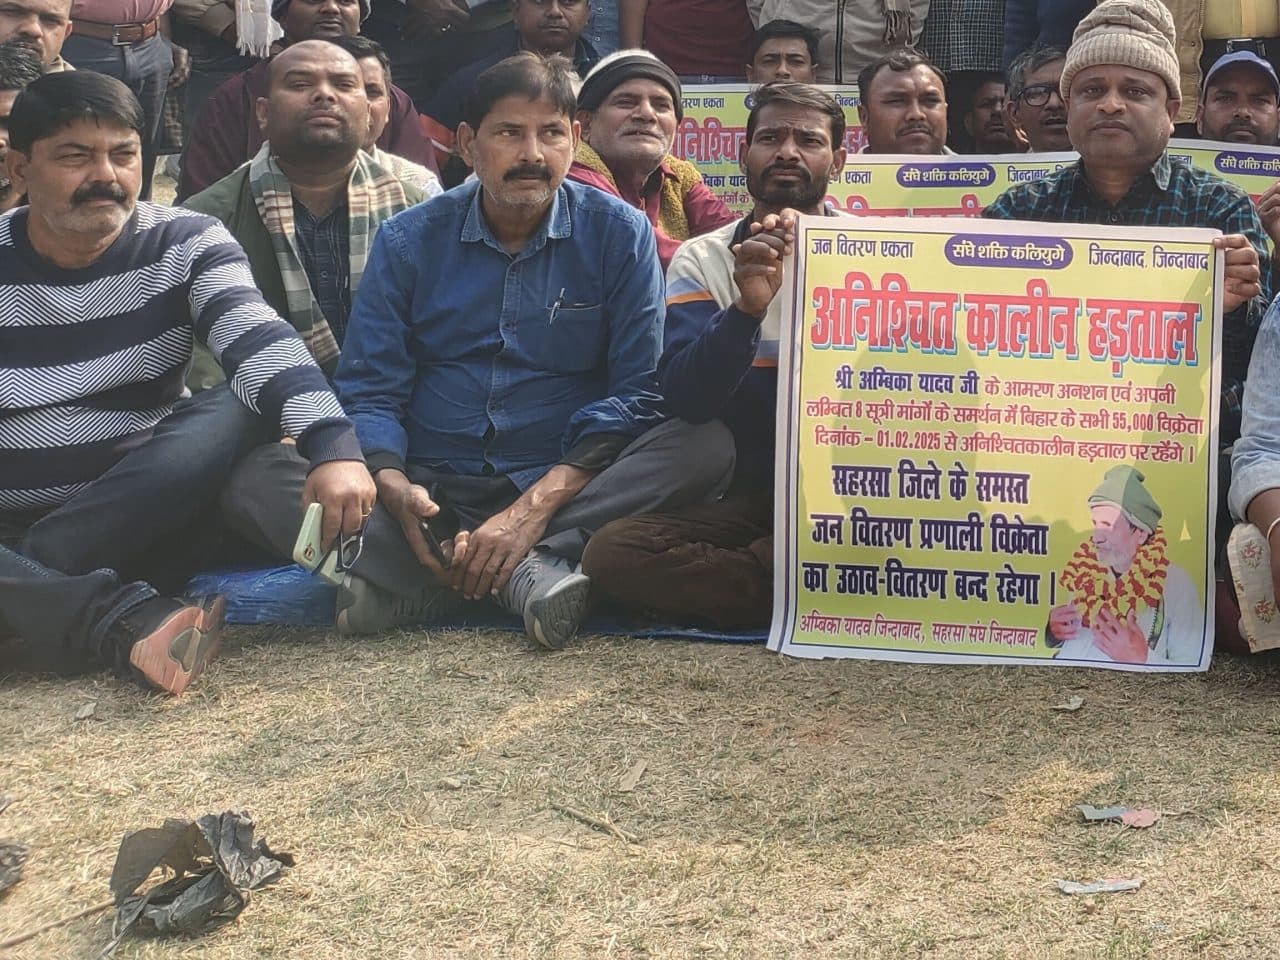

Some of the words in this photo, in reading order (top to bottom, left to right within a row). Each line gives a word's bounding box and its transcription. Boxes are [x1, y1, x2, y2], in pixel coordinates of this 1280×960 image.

[812, 239, 832, 255] जन
[837, 233, 877, 257] वितरण
[881, 241, 914, 258] एकता
[978, 242, 1010, 258] शक्ति
[1011, 243, 1065, 265] कलियुगे
[1153, 245, 1210, 271] जिन्दाबाद
[810, 271, 962, 353] अनिश्चित
[964, 278, 1082, 359] कालीन
[1086, 298, 1202, 378] हड़ताल
[835, 366, 854, 389] श्री
[859, 367, 913, 391] अम्बिका
[918, 374, 955, 393] यादव
[959, 370, 980, 394] जी
[985, 376, 1001, 395] के
[1004, 381, 1055, 398] आमरण
[1057, 384, 1108, 400] अनशन
[1111, 381, 1132, 402] एवं
[1134, 383, 1176, 404] अपनी
[806, 396, 853, 417] लम्बित
[856, 401, 862, 418] 8
[865, 399, 895, 425] सूत्री
[897, 400, 932, 421] मांगों
[935, 402, 951, 422] के
[953, 403, 1002, 424] समर्थन
[1004, 404, 1018, 424] में
[1020, 405, 1059, 427] बिहार
[1061, 408, 1077, 427] के
[1079, 409, 1110, 429] सभी
[1113, 412, 1153, 432] 55,000
[1157, 412, 1204, 435] विक्रेता
[815, 425, 862, 446] दिनांक
[877, 430, 940, 449] 01.02.2025
[944, 431, 958, 451] से
[960, 432, 1075, 456] अनिश्चितकालीन
[1078, 442, 1128, 463] हड़ताल
[1129, 445, 1150, 460] पर
[1151, 440, 1184, 462] रहेंगे
[832, 465, 892, 497] सहरसा
[898, 459, 942, 500] जिले
[948, 461, 969, 501] के
[975, 472, 1030, 504] समस्त
[811, 514, 844, 545] जन
[850, 507, 913, 548] वितरण
[919, 512, 984, 552] प्रणाली
[990, 514, 1049, 555] विक्रेता
[802, 562, 829, 592] का
[835, 558, 948, 599] उठाव-वितरण
[954, 570, 989, 601] बन्द
[995, 564, 1040, 605] रहेगा
[800, 610, 842, 634] अम्बिका
[844, 618, 873, 639] यादव
[932, 623, 967, 644] सहरसा
[969, 625, 987, 643] संघ
[989, 620, 1038, 648] जिन्दाबाद
